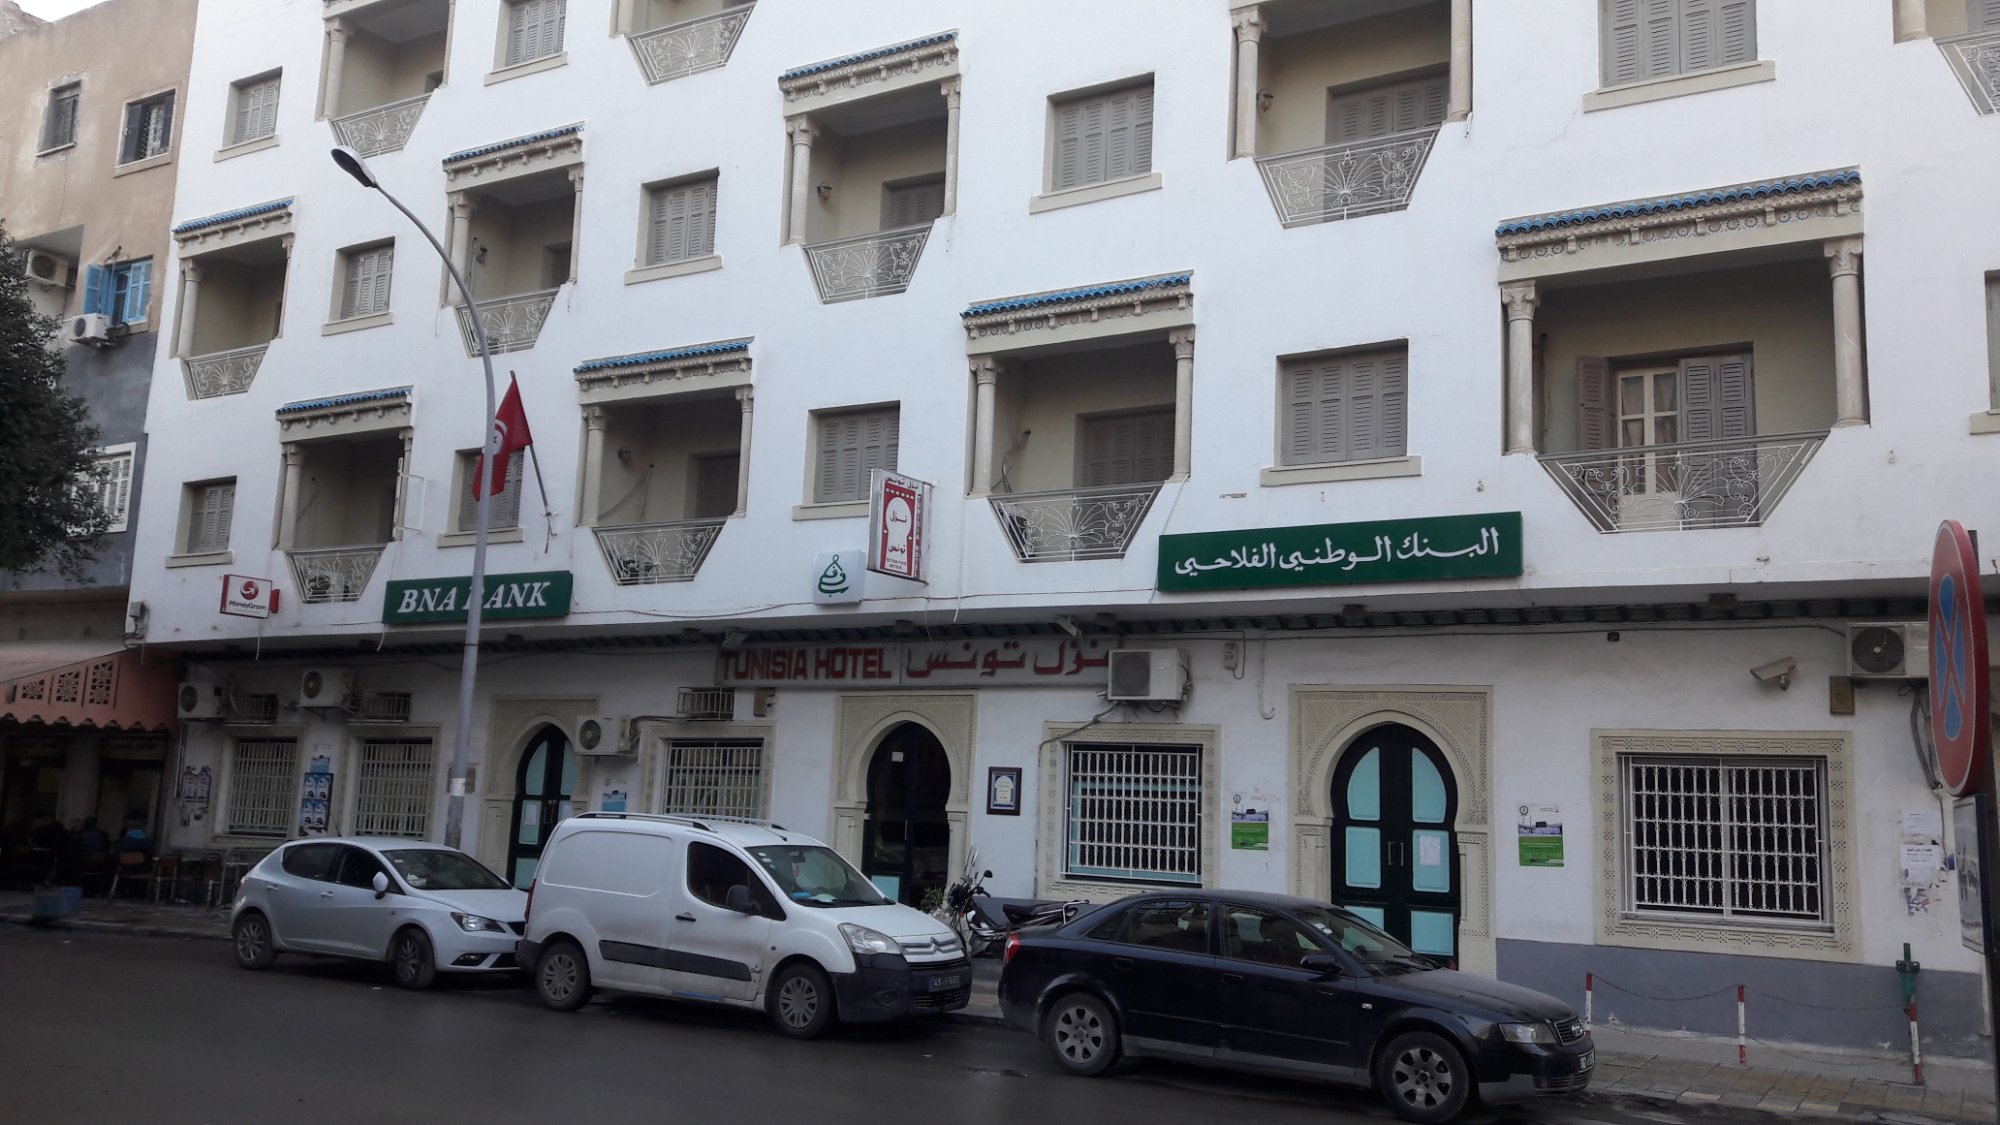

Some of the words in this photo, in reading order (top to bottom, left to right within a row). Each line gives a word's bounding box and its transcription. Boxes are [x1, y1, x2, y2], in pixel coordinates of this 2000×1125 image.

[1174, 542, 1275, 577] الفلاحي
[1279, 536, 1392, 572] الوطني
[1396, 526, 1499, 559] البنك
[397, 586, 457, 613] BNA
[720, 648, 808, 680] TUNISIA
[814, 647, 892, 679] HOTEL
[906, 641, 1026, 678] تونس
